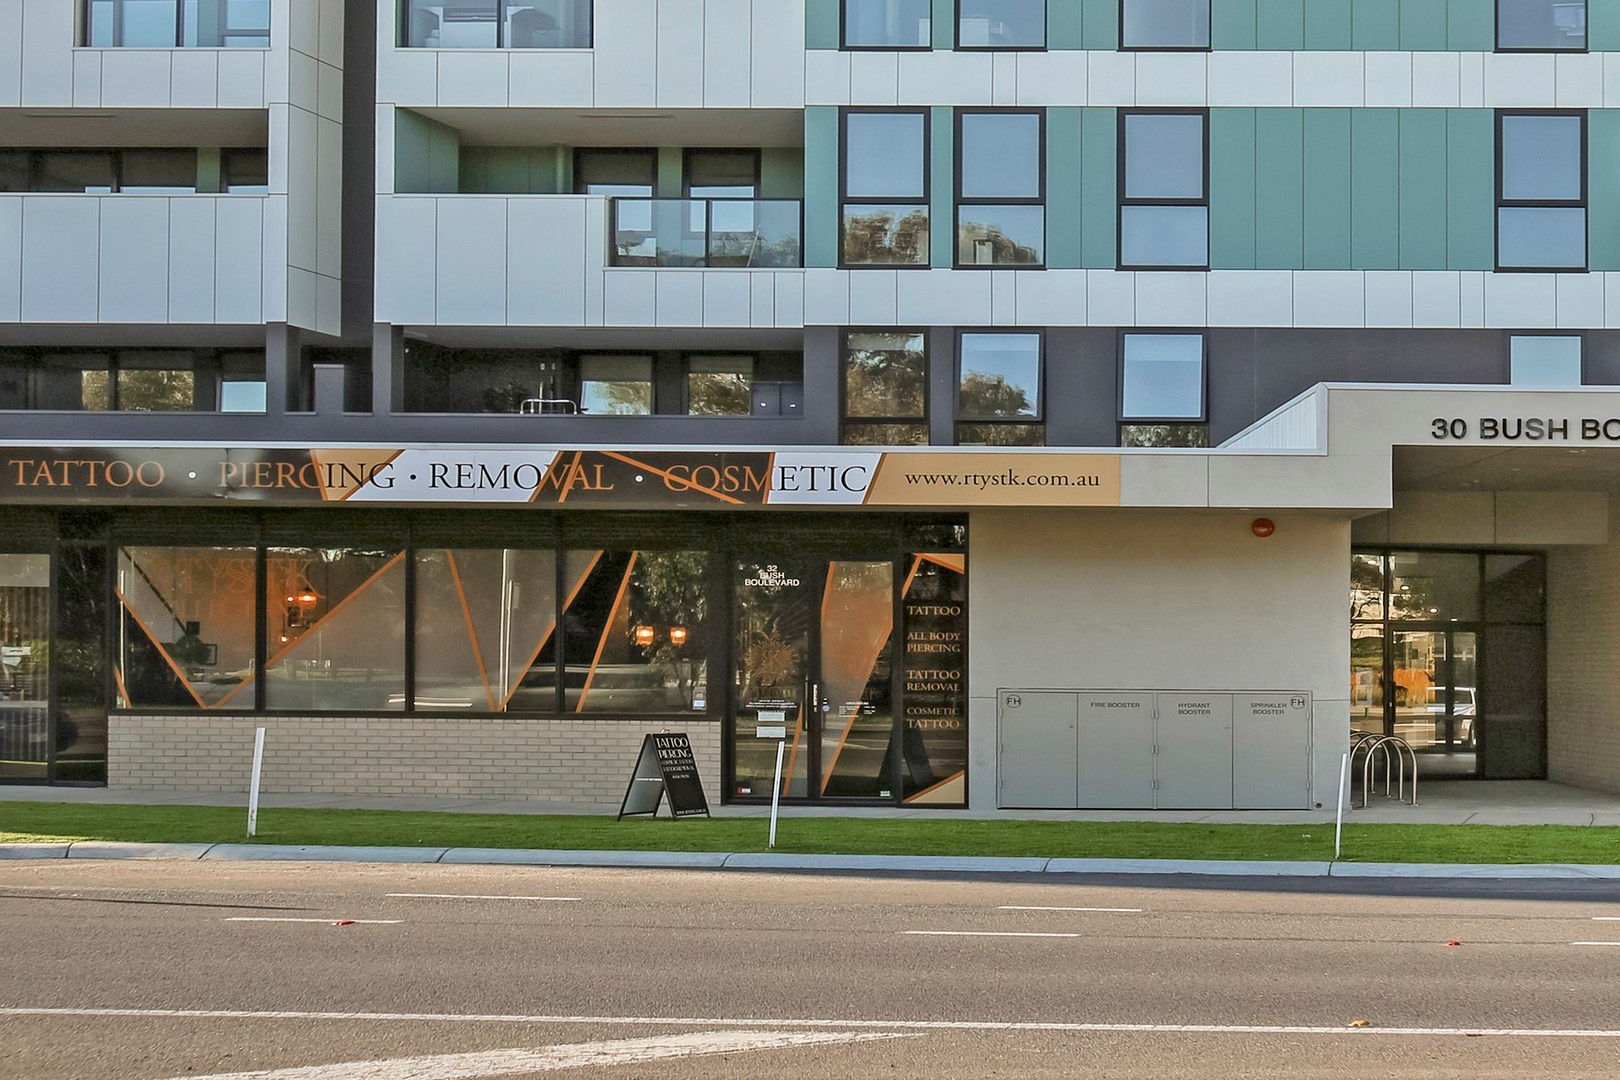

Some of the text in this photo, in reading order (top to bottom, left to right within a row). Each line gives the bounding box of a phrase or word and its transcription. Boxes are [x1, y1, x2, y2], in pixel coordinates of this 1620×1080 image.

[1431, 418, 1468, 440] 30
[1480, 418, 1568, 440] BUSH
[9, 460, 868, 493] TATTOO PIERCING REMOVAL COSMETIC
[904, 468, 1100, 491] www.rtystk.com.au
[907, 606, 960, 615] TATTOO
[907, 632, 960, 640] ALL BODY
[907, 644, 960, 652] PIERCING
[907, 670, 960, 680] TATTOO
[907, 683, 960, 691] REMOVAL
[907, 707, 960, 715] COSMETIC
[906, 719, 960, 728] TATTOO
[656, 738, 688, 748] TATTOO
[658, 749, 691, 758] PIERCING
